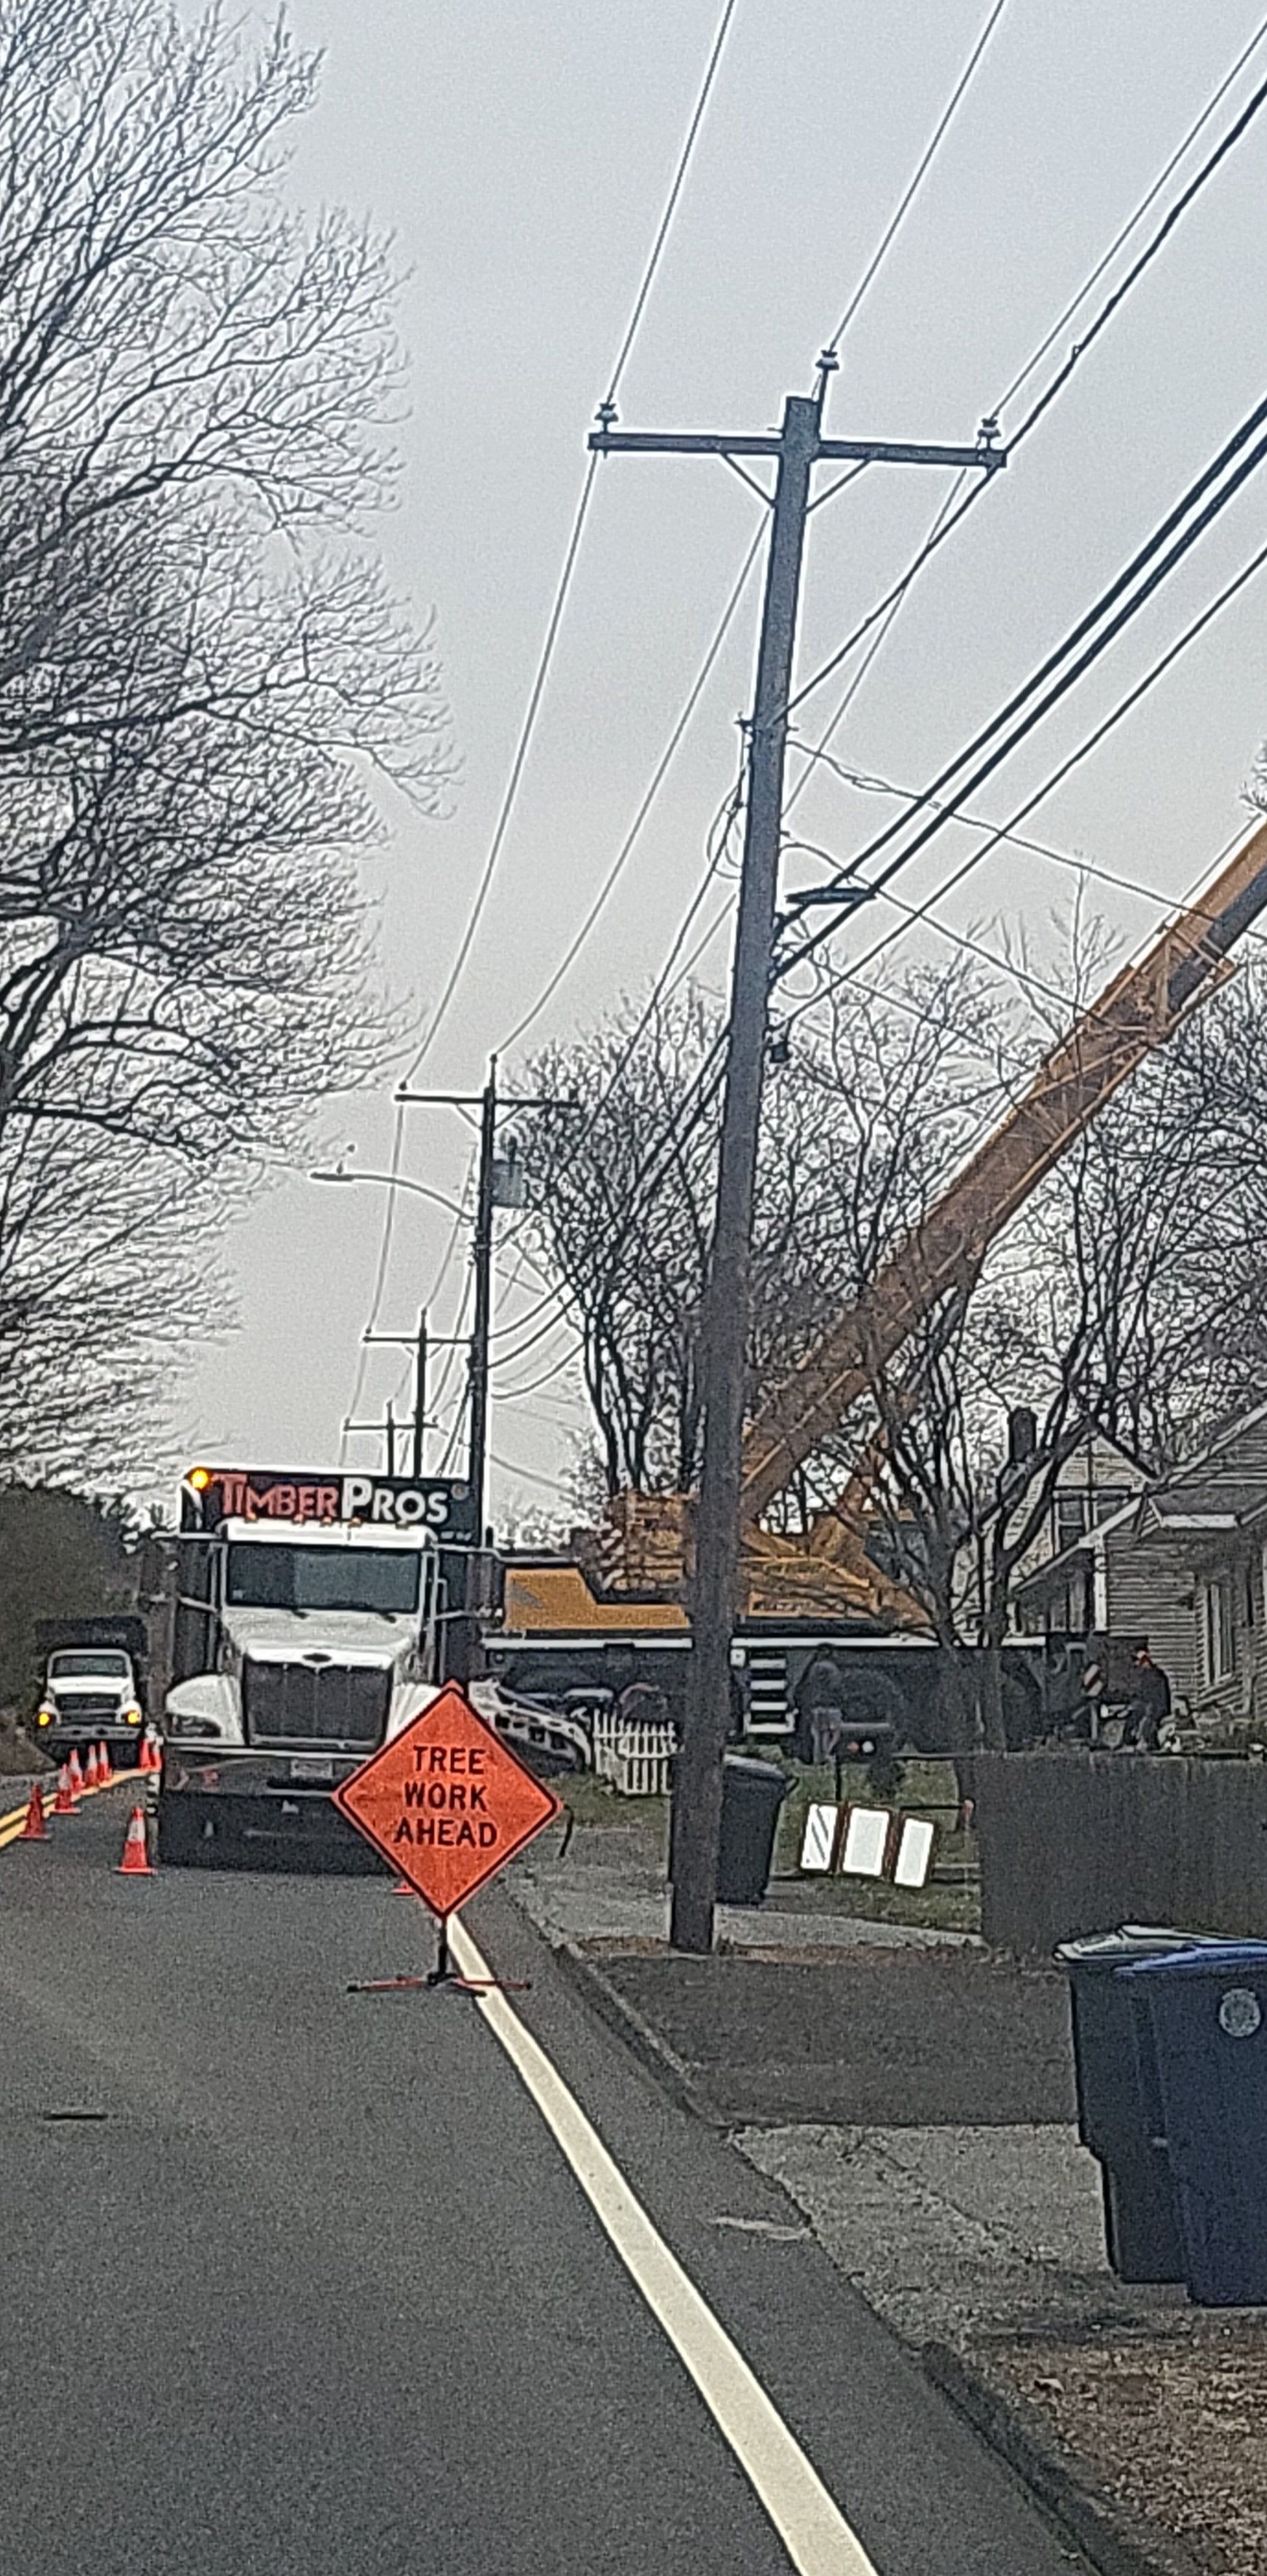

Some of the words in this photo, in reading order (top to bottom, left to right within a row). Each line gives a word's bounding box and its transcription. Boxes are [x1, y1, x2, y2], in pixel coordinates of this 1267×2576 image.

[413, 1745, 485, 1774] TREE
[405, 1781, 487, 1812] WORK
[394, 1817, 497, 1848] AHEAD
